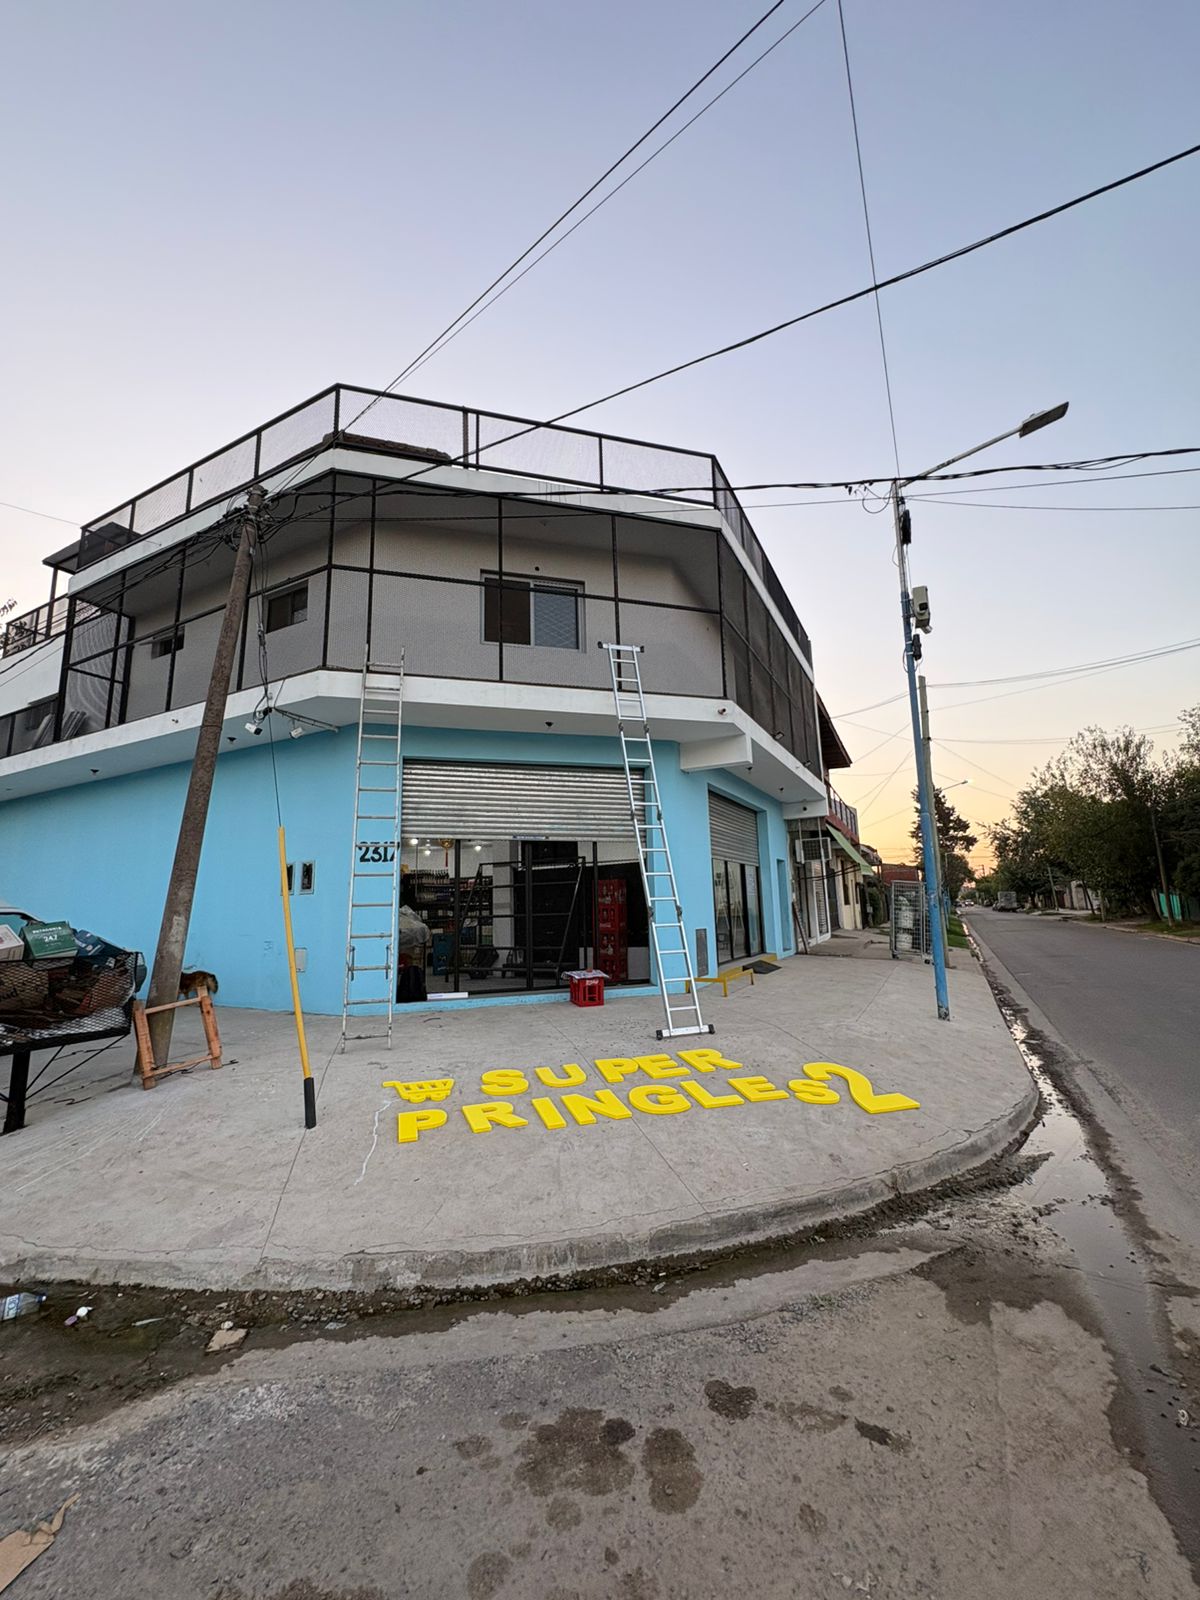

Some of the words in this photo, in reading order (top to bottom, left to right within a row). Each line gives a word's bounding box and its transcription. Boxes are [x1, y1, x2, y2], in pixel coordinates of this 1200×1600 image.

[358, 841, 400, 863] 2317
[480, 1048, 743, 1097] SUPER
[397, 1076, 840, 1144] PRINGLES
[803, 1062, 920, 1114] 2
